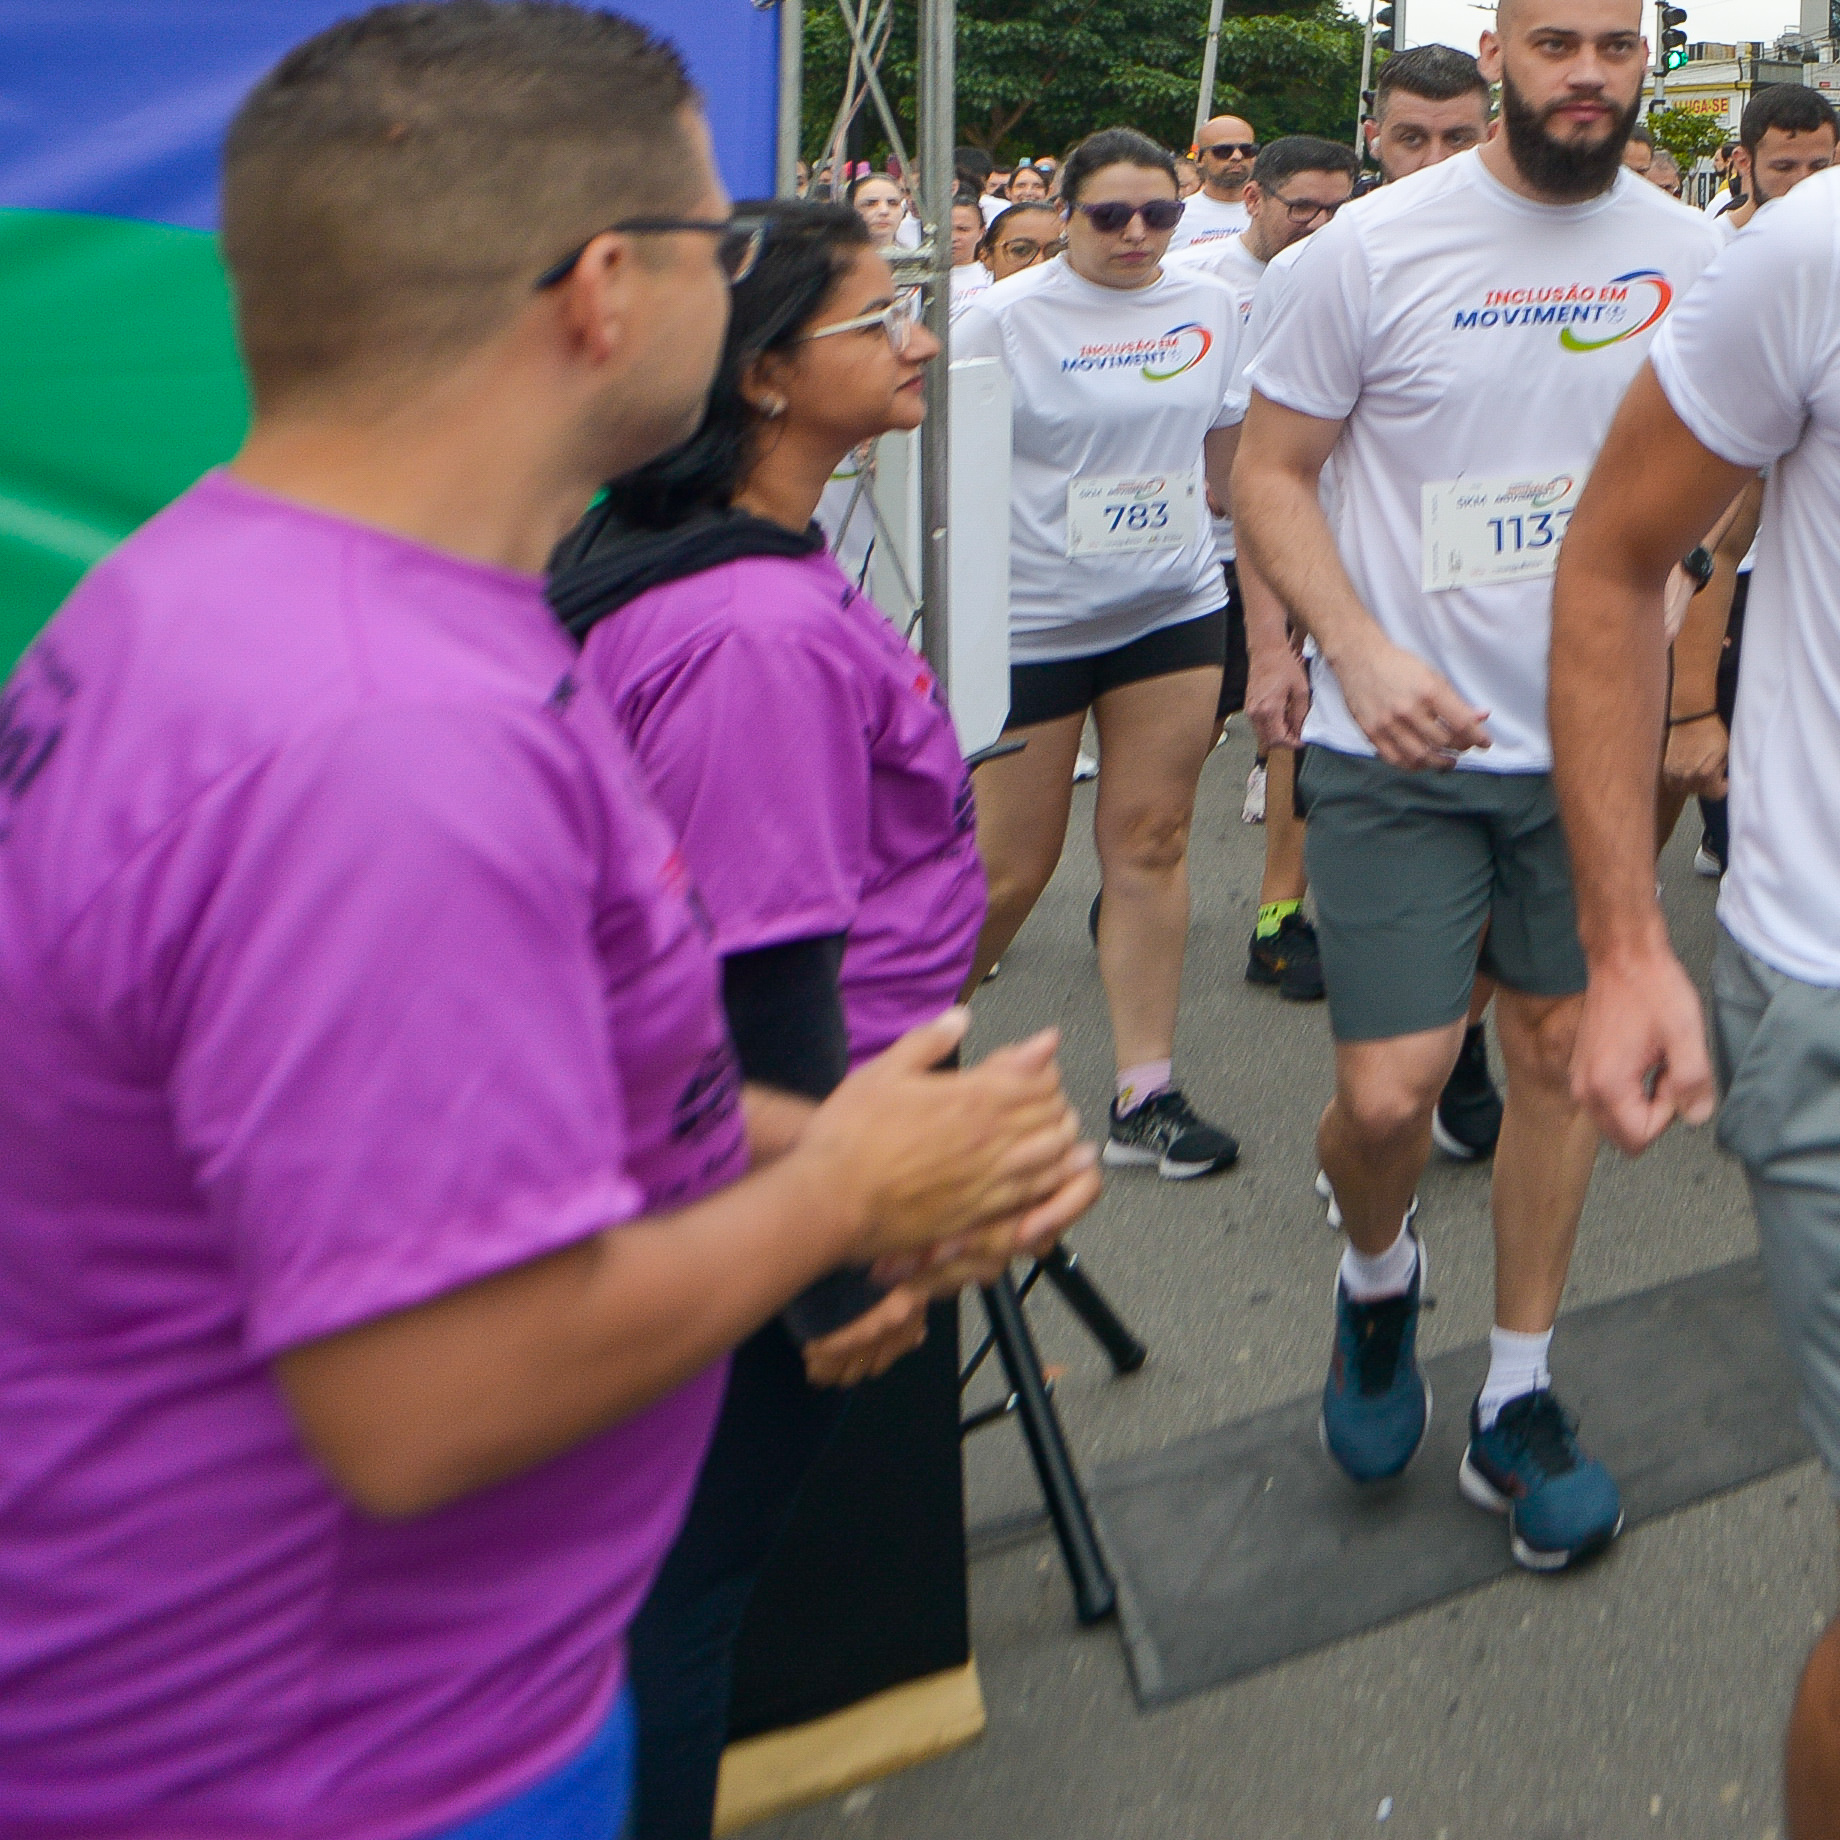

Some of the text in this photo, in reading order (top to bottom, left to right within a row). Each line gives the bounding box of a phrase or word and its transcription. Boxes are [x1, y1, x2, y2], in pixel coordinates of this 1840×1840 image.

[1485, 282, 1630, 307] INCLUSÃO EM
[1103, 500, 1169, 533] 783
